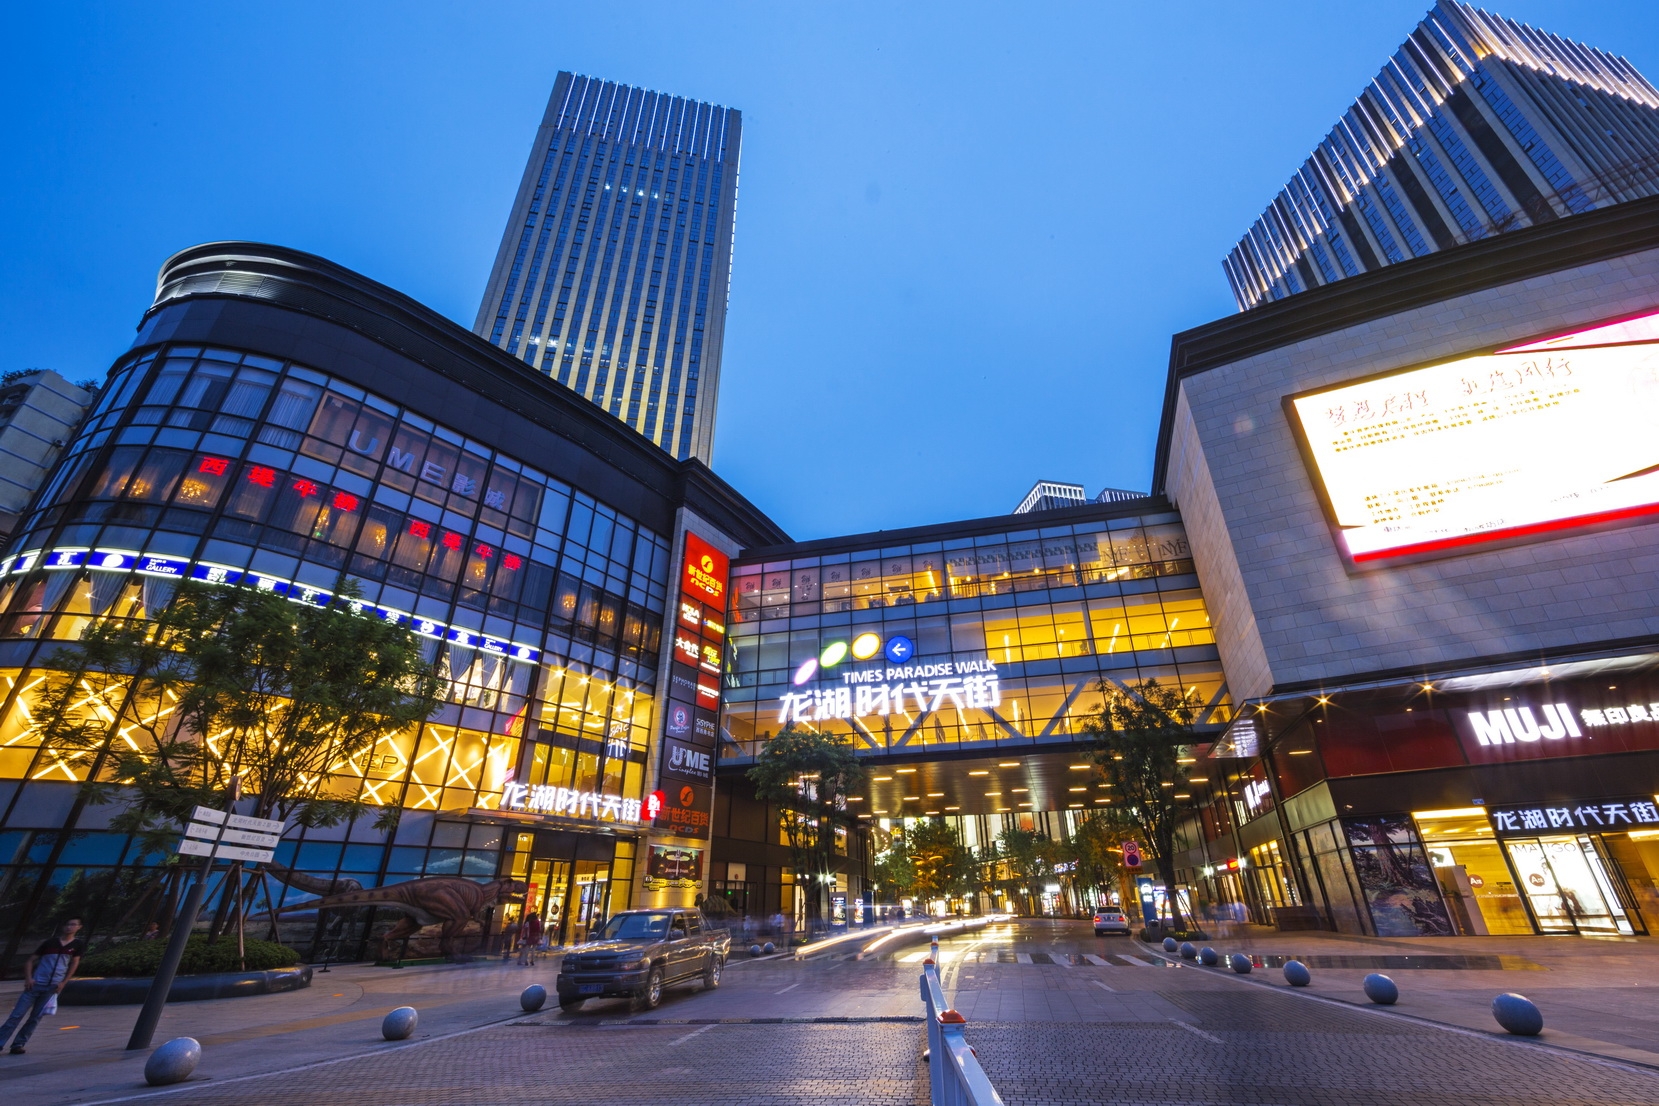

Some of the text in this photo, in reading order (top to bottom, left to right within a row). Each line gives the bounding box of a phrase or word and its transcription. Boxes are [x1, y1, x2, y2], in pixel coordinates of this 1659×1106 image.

[145, 564, 178, 574] GALLERY
[688, 564, 723, 593] 新世纪百货
[842, 659, 997, 684] TIMES PARADISE WALK
[777, 674, 1002, 724] 龙湖时代天街
[1467, 703, 1583, 746] MUJI
[500, 781, 642, 822] 龙湖时代天街
[1493, 801, 1659, 831] 龙湖时代天街
[660, 806, 709, 827] 新世纪百货
